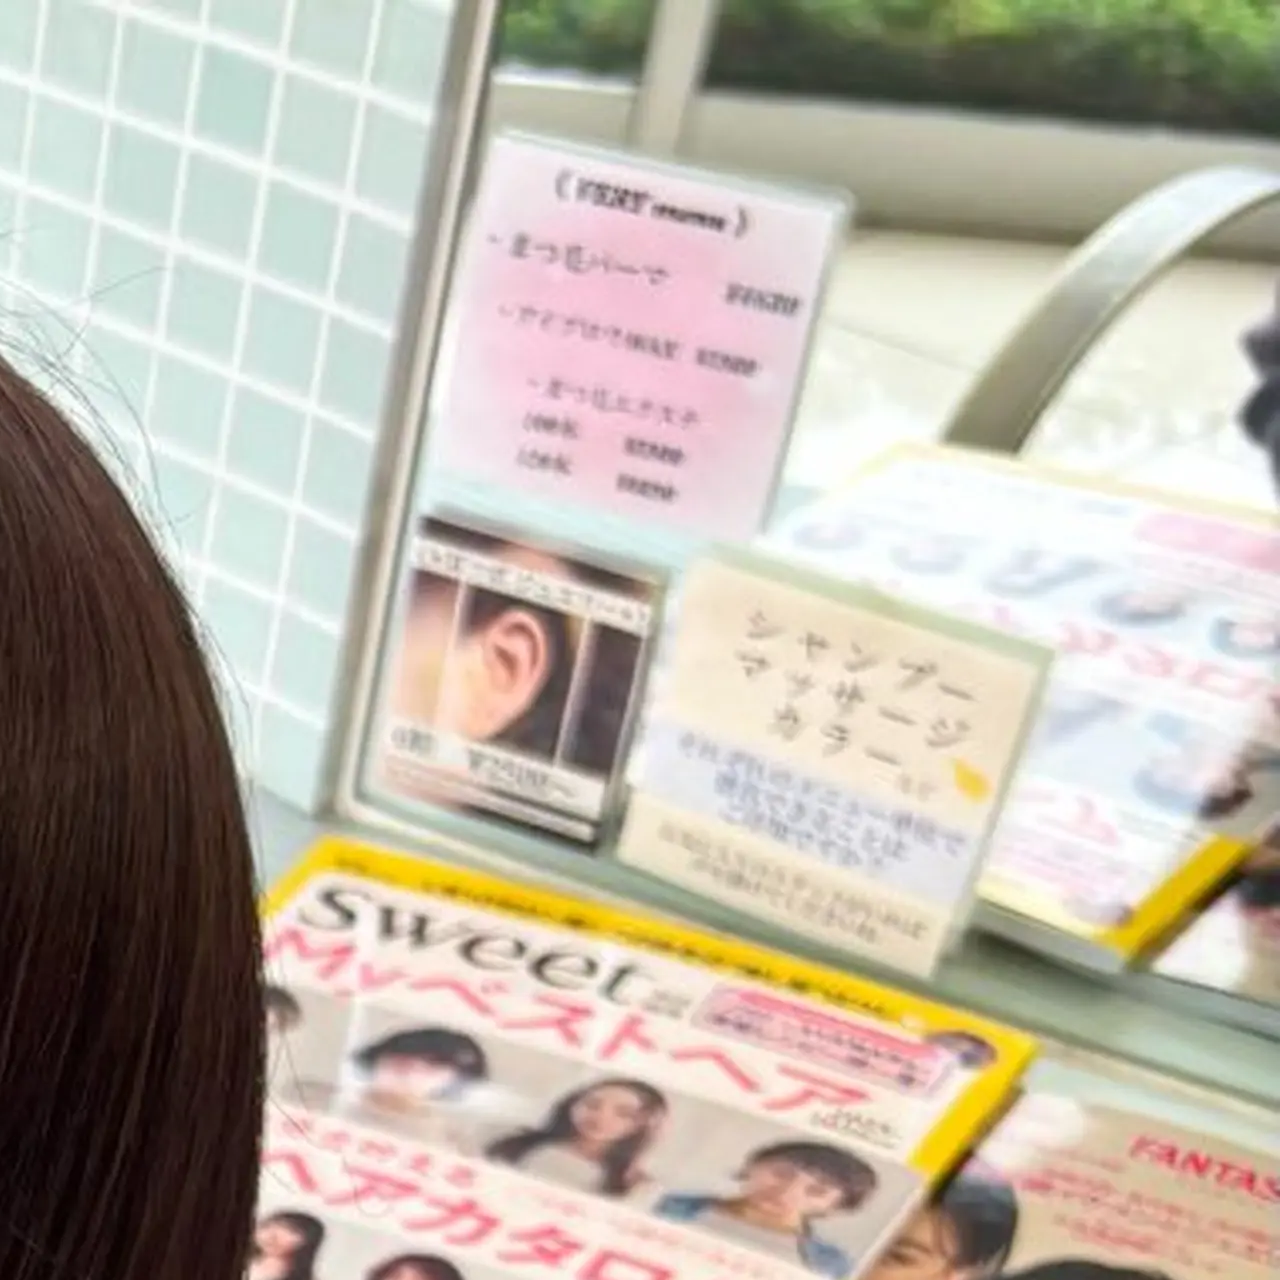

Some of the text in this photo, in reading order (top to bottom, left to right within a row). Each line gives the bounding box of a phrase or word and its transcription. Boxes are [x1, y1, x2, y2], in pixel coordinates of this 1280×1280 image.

[745, 610, 977, 701] シャンプー
[297, 886, 642, 1003] sweet
